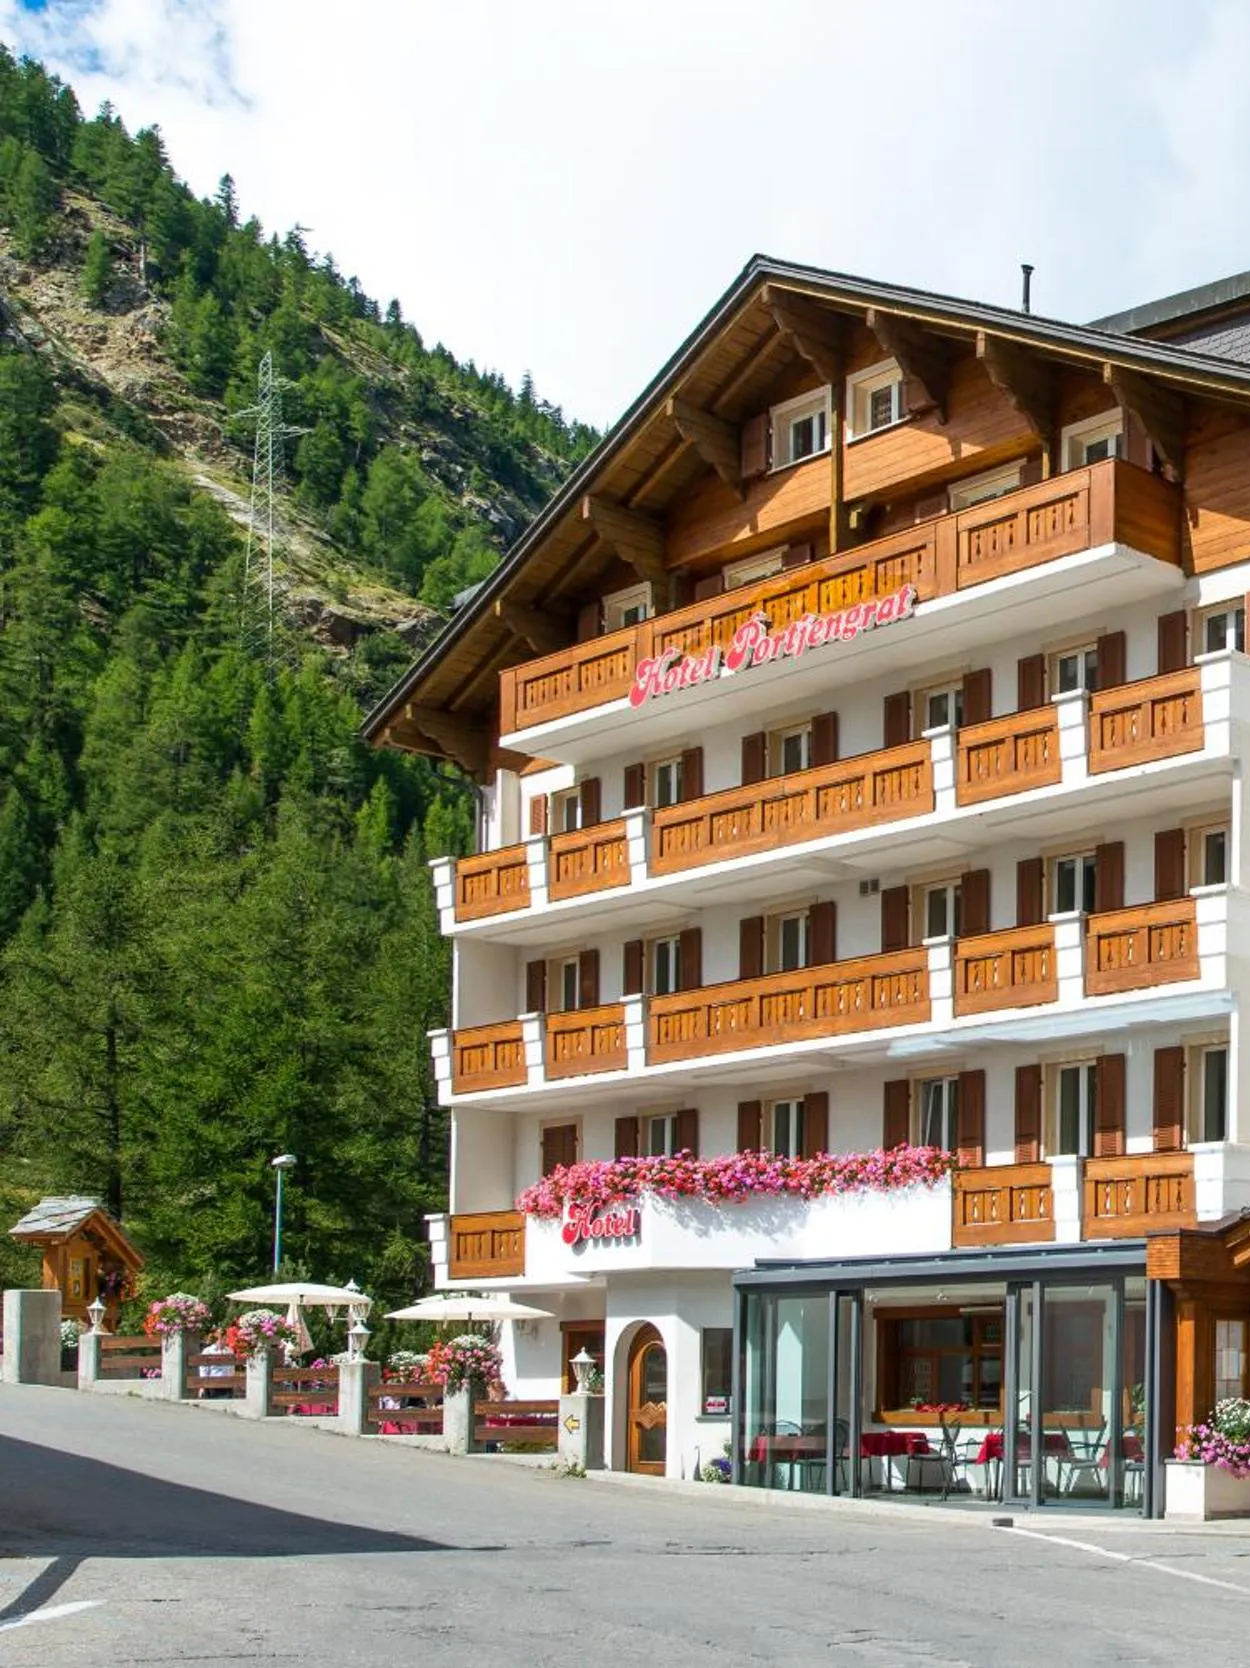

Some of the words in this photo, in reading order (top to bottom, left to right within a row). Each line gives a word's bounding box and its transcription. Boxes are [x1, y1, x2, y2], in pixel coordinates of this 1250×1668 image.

[629, 646, 720, 708] Hotel
[725, 583, 917, 671] Portjengrat
[562, 1200, 636, 1244] Hotel
